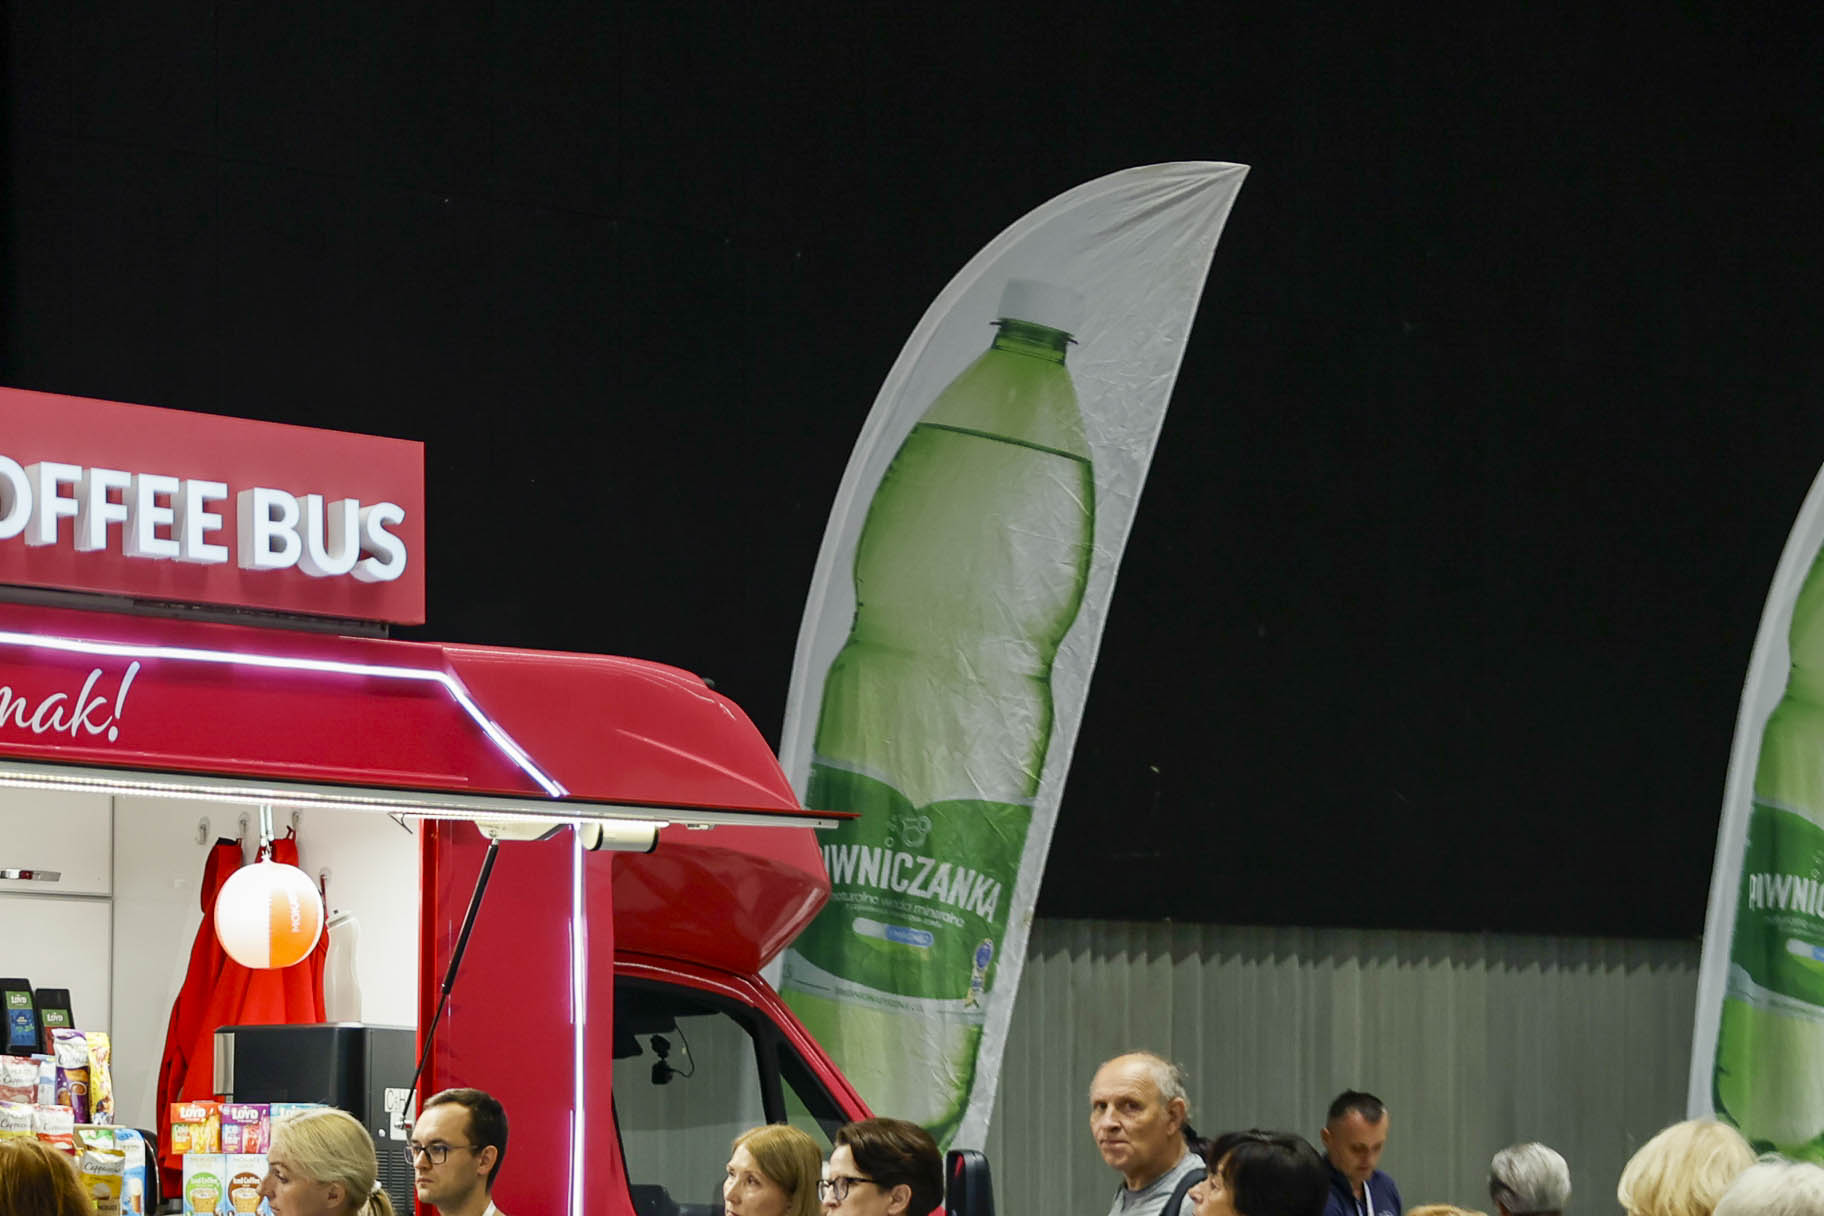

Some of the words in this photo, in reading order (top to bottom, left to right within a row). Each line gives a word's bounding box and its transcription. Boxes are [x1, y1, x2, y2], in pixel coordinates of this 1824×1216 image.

[237, 486, 408, 583] BUS
[180, 1106, 207, 1119] LOYD
[231, 1106, 259, 1120] LOYD
